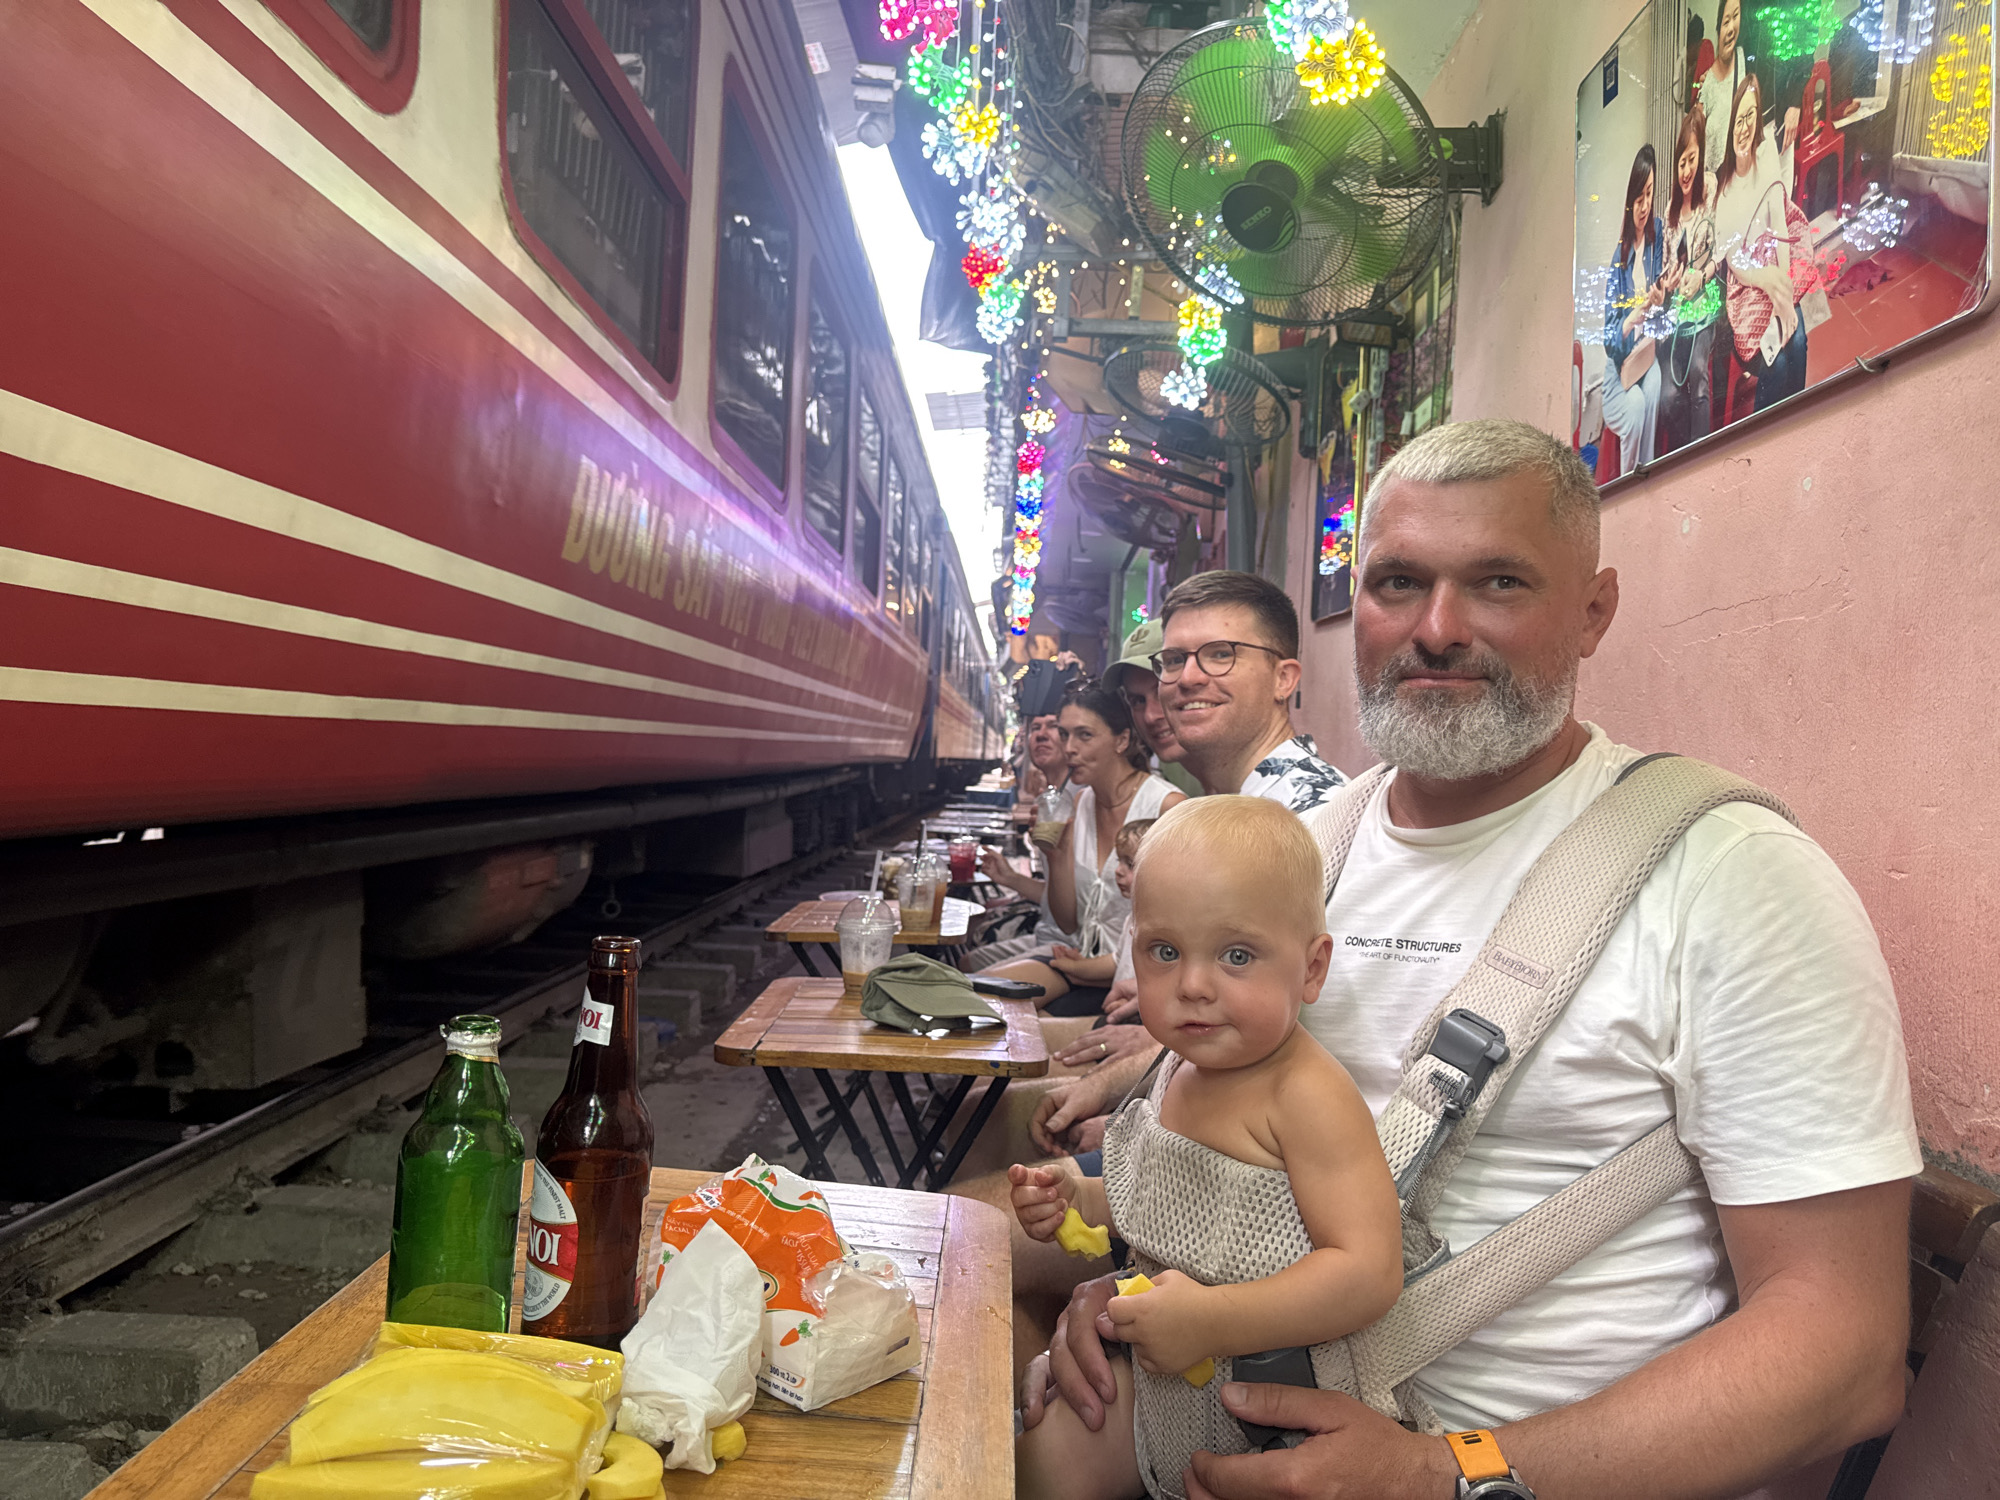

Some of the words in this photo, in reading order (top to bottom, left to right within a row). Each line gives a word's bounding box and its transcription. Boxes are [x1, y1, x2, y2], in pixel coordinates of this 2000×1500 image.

[1345, 936, 1392, 948] CONCRETE
[1396, 938, 1462, 953] STRUCTURES
[548, 1184, 560, 1203] FINEST
[556, 1200, 567, 1220] MALT
[665, 1222, 690, 1235] FACIAL
[547, 1282, 561, 1301] WORLD
